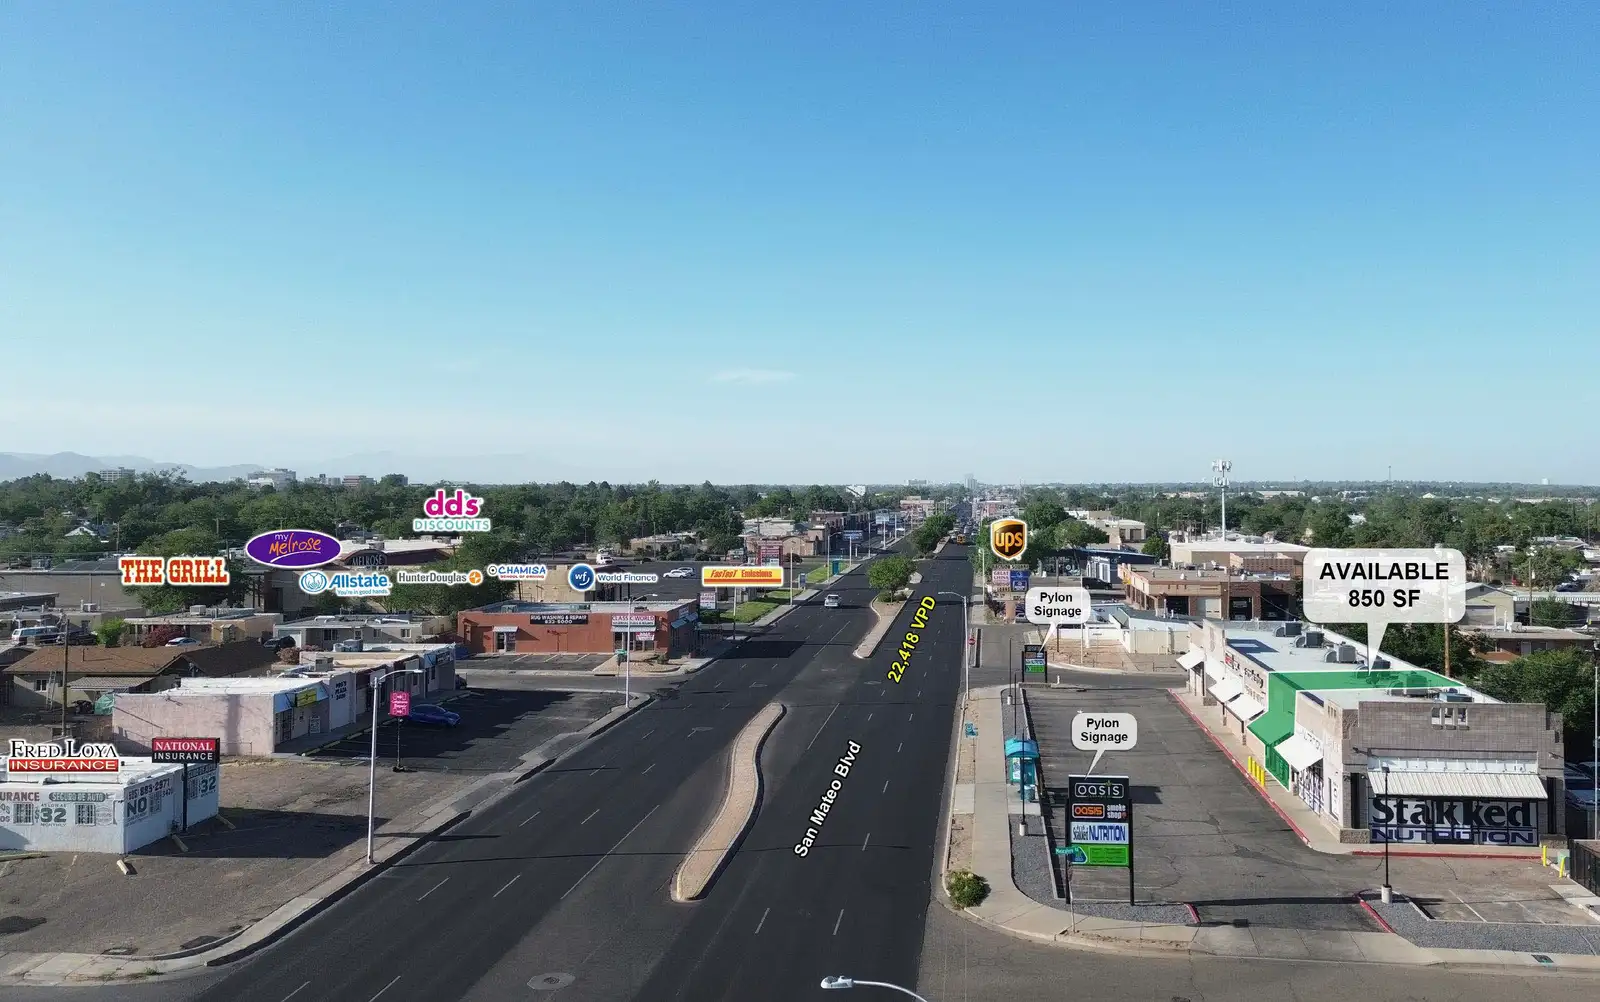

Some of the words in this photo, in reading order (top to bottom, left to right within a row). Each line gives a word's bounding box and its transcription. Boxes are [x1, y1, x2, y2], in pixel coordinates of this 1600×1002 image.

[155, 741, 213, 751] NATIONAL
[154, 752, 213, 760] INSURANCE
[87, 792, 104, 801] AUTO
[127, 796, 148, 818] NO
[1107, 803, 1126, 812] smoke
[1107, 811, 1122, 820] shop
[1372, 797, 1532, 827] Stakked
[1089, 825, 1126, 841] NUTRITION
